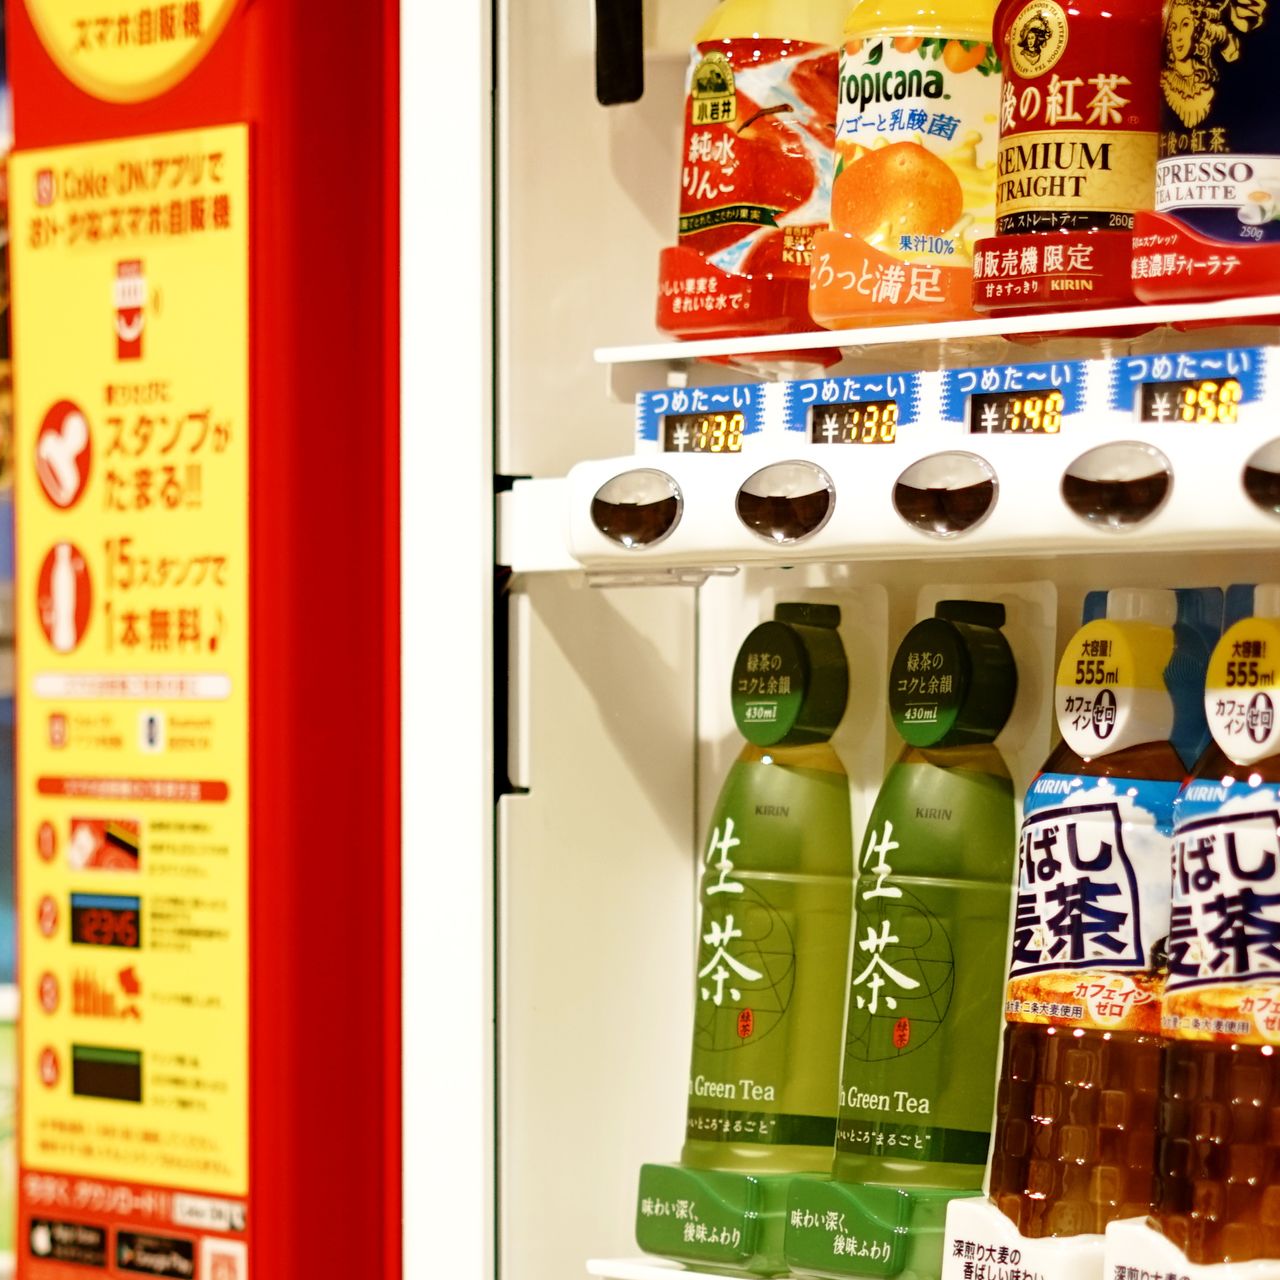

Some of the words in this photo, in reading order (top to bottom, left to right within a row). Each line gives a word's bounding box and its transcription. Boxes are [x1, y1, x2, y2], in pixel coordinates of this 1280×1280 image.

[697, 101, 733, 121] 小岩井
[688, 132, 737, 164] 純水
[682, 161, 740, 200] りんご
[1176, 185, 1237, 201] LATTE
[899, 235, 955, 255] 果汁10%
[1240, 226, 1264, 242] 250g
[986, 281, 1038, 298] 甘さすっきり
[1051, 279, 1094, 292] KIRIN
[822, 403, 898, 444] ¥130
[981, 392, 1064, 433] ¥140
[106, 411, 232, 456] スタンプが
[673, 413, 745, 452] ¥130
[1081, 639, 1113, 658] 大容量!
[747, 653, 782, 672] 緑茶の
[907, 652, 944, 672] 緑茶の
[1075, 660, 1119, 685] 555ml
[738, 675, 792, 695] コクと余韻
[897, 675, 953, 695] コクと余韻
[1226, 661, 1275, 687] 555ml
[744, 706, 778, 721] 430ml
[904, 706, 939, 721] 430ml
[1033, 779, 1072, 795] KIRIN
[1185, 786, 1227, 801] KIRIN
[755, 805, 789, 817] KIRIN
[915, 807, 953, 821] KIRIN
[1020, 823, 1112, 884] ばし
[1172, 831, 1276, 896] ばし
[1073, 982, 1153, 1005] カフェイン
[1096, 1002, 1124, 1017] ゼロ
[738, 1012, 752, 1036] 緑茶
[895, 1021, 908, 1047] 緑茶
[694, 1075, 736, 1099] Green
[739, 1080, 776, 1102] Tea
[847, 1086, 891, 1111] Green
[894, 1091, 931, 1115] Tea
[683, 1223, 741, 1248] 後味ふわり
[833, 1235, 891, 1263] 後味ふわり
[952, 1239, 1020, 1265] 深煎り大麦の
